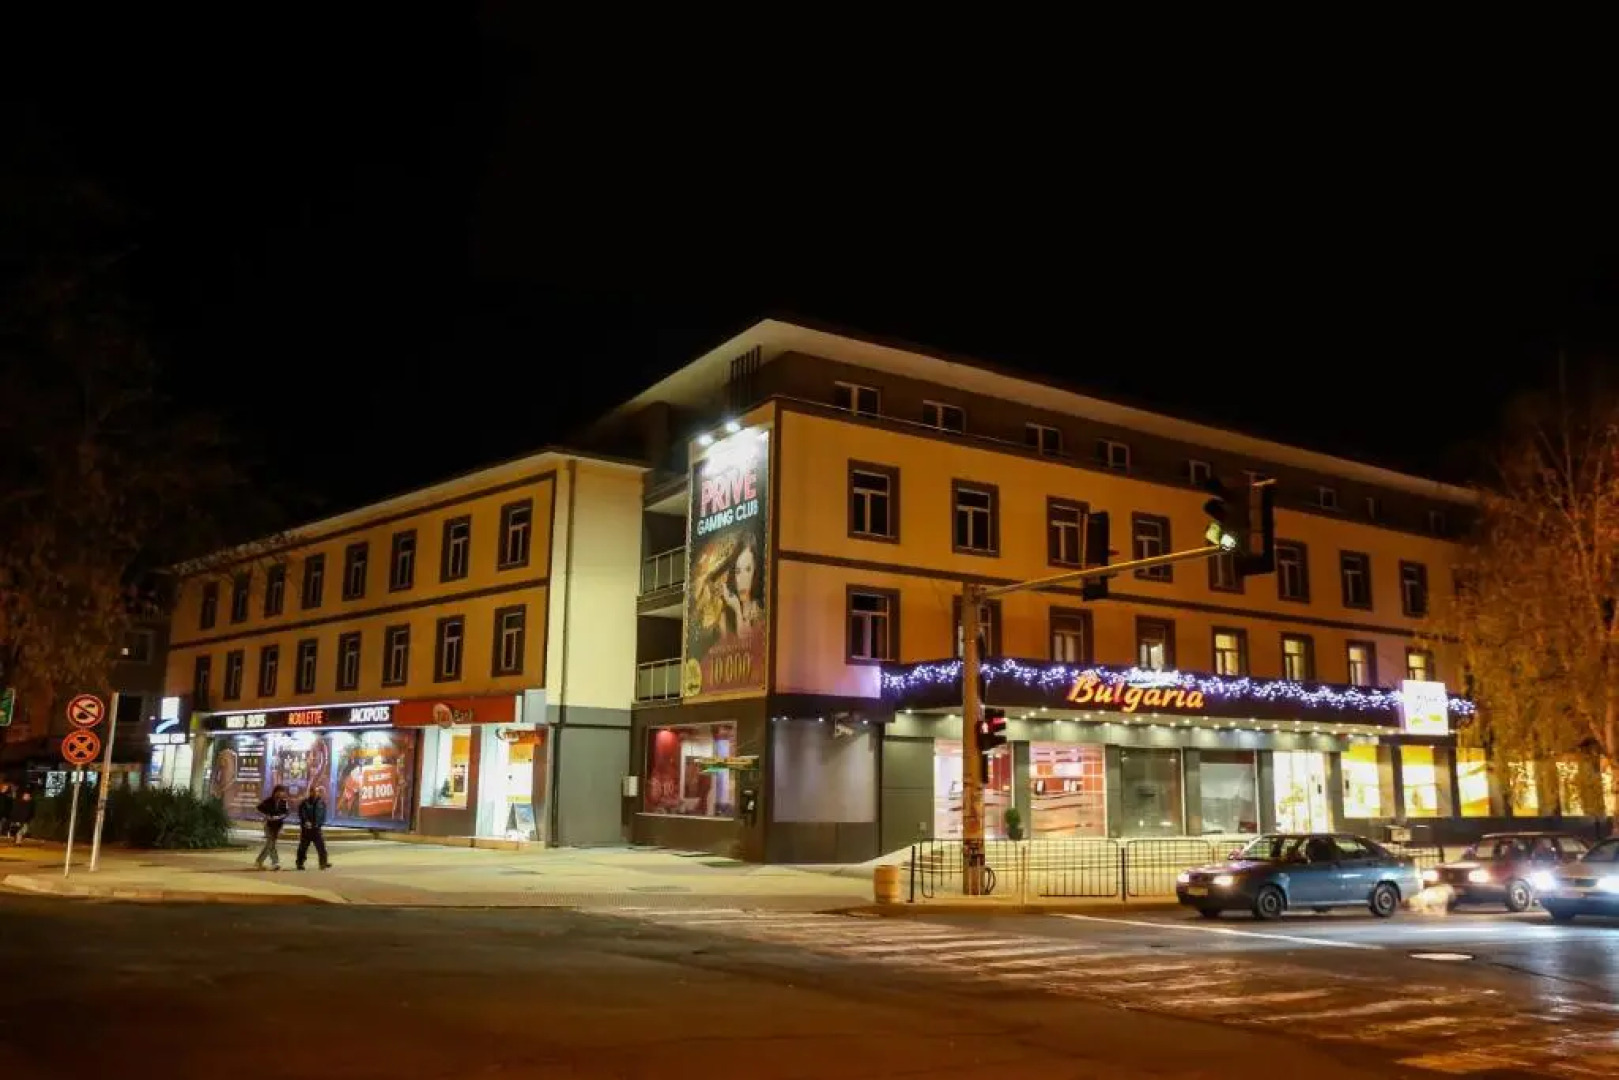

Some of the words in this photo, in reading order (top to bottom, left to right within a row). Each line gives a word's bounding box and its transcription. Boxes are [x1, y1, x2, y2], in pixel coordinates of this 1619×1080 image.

[697, 509, 733, 536] GAMING
[735, 499, 759, 521] CLUB
[1067, 673, 1204, 712] Bulgaria
[288, 711, 323, 725] ROULETTE
[349, 707, 390, 723] JACKPOTS
